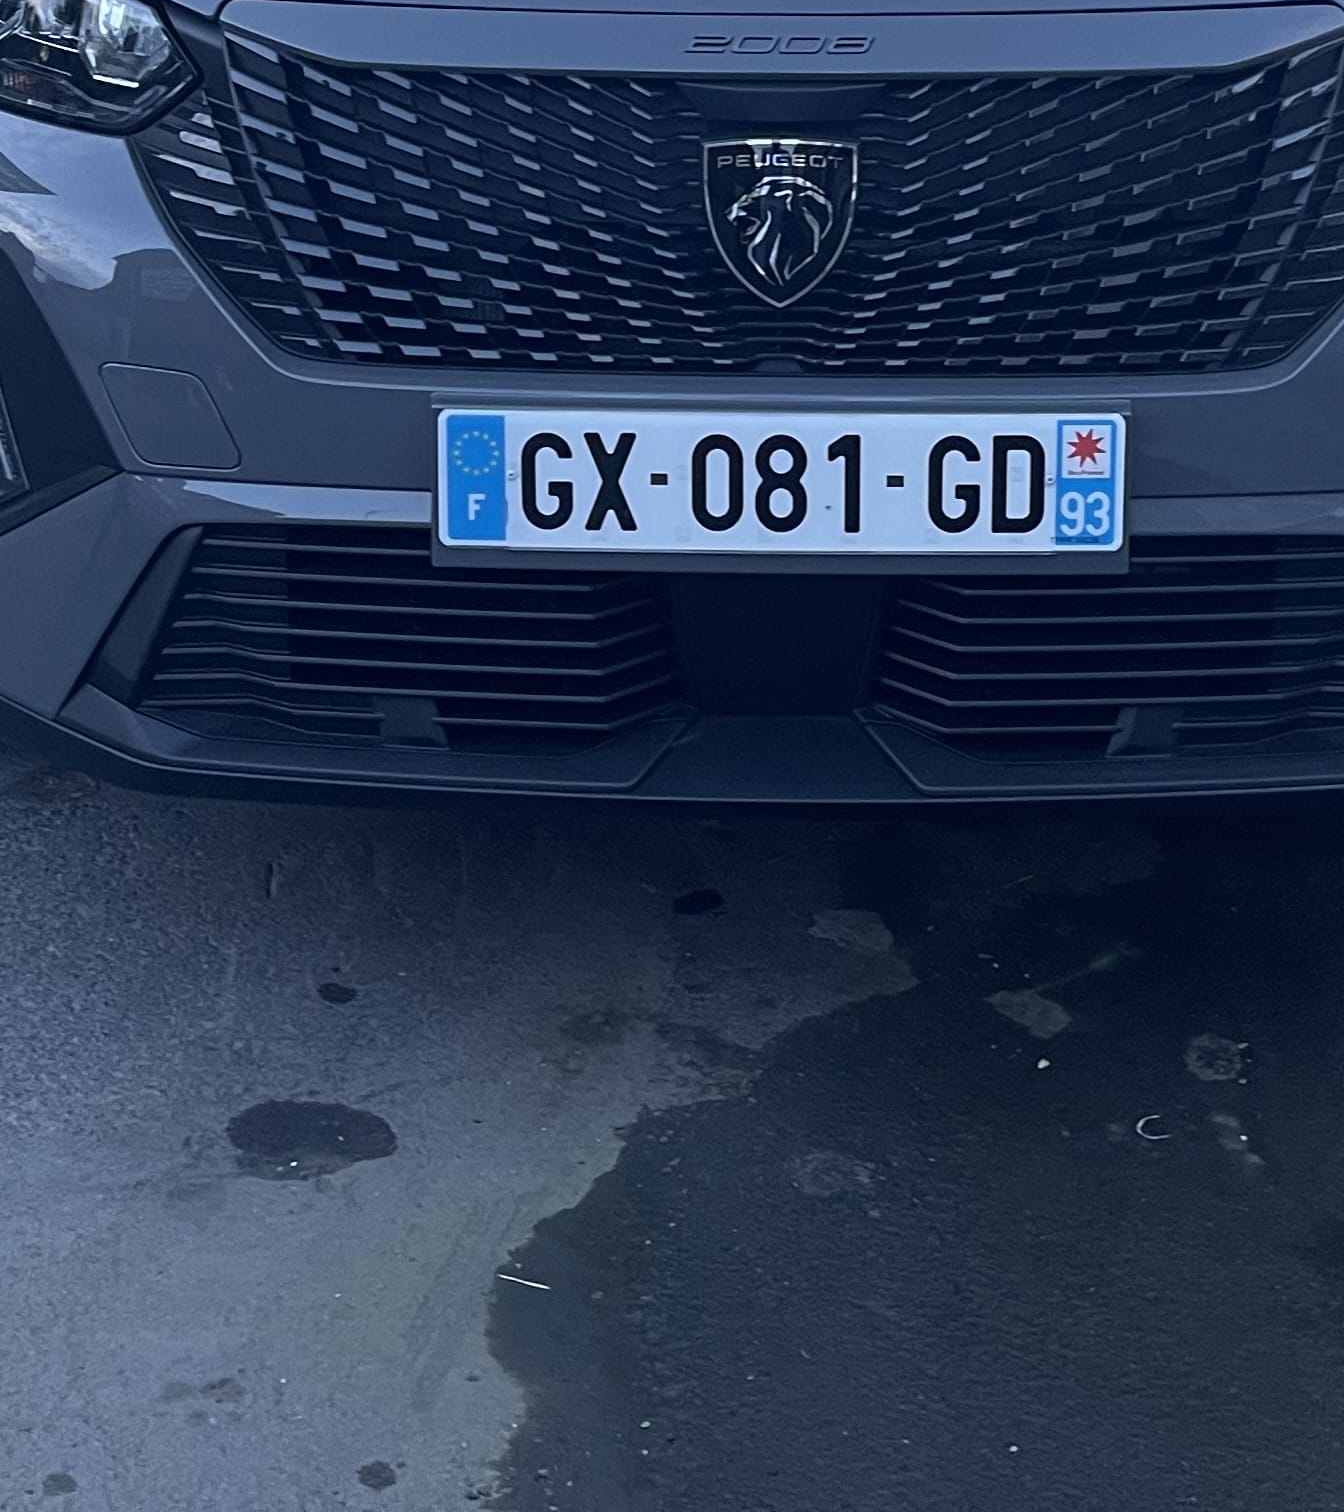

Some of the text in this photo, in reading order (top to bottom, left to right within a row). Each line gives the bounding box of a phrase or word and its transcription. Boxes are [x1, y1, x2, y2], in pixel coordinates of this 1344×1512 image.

[684, 35, 876, 55] 2008
[716, 153, 844, 169] PEUGEOT
[519, 431, 1047, 534] GX-081-GD
[467, 492, 486, 521] F
[1059, 490, 1112, 536] 93
